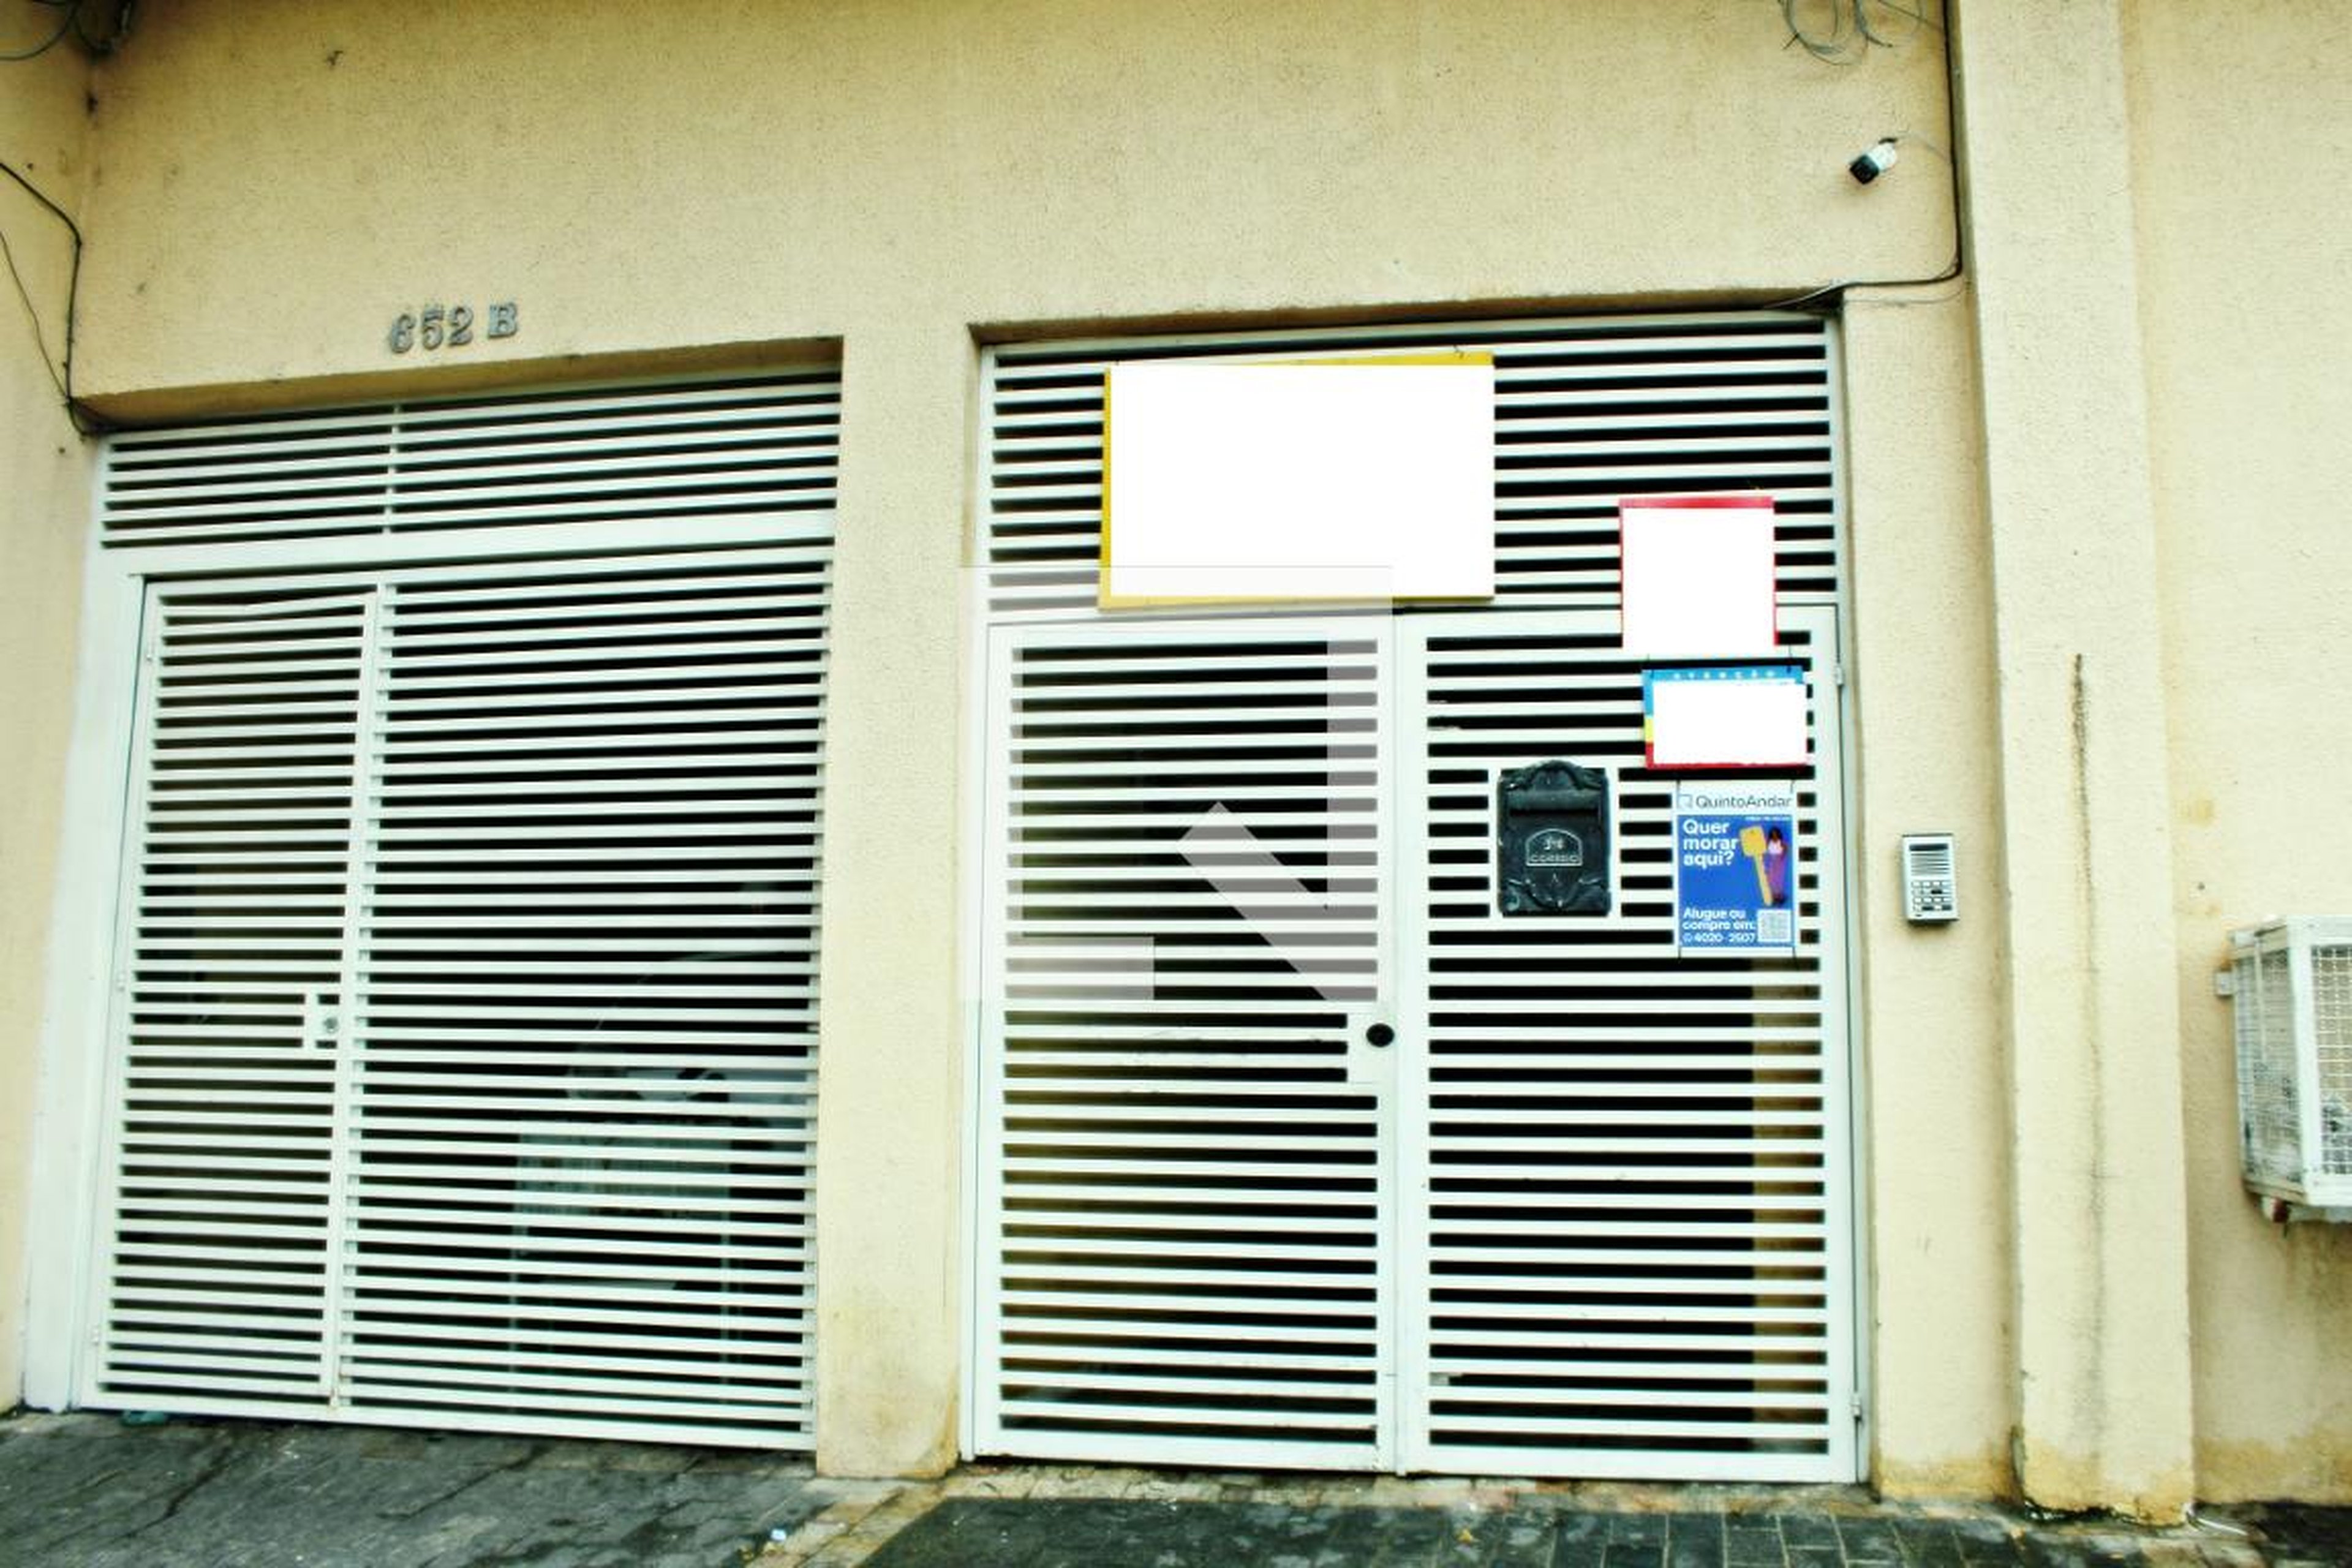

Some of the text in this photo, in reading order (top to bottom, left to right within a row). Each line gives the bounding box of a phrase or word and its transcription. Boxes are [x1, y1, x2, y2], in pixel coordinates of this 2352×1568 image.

[390, 303, 518, 353] 652 B
[1695, 794, 1792, 809] QuintoAndar
[1683, 819, 1730, 835] Quer
[1683, 838, 1738, 850] morar
[1683, 851, 1735, 870] aqui?
[1683, 907, 1746, 921] Alugue ou
[1682, 921, 1731, 931] compre
